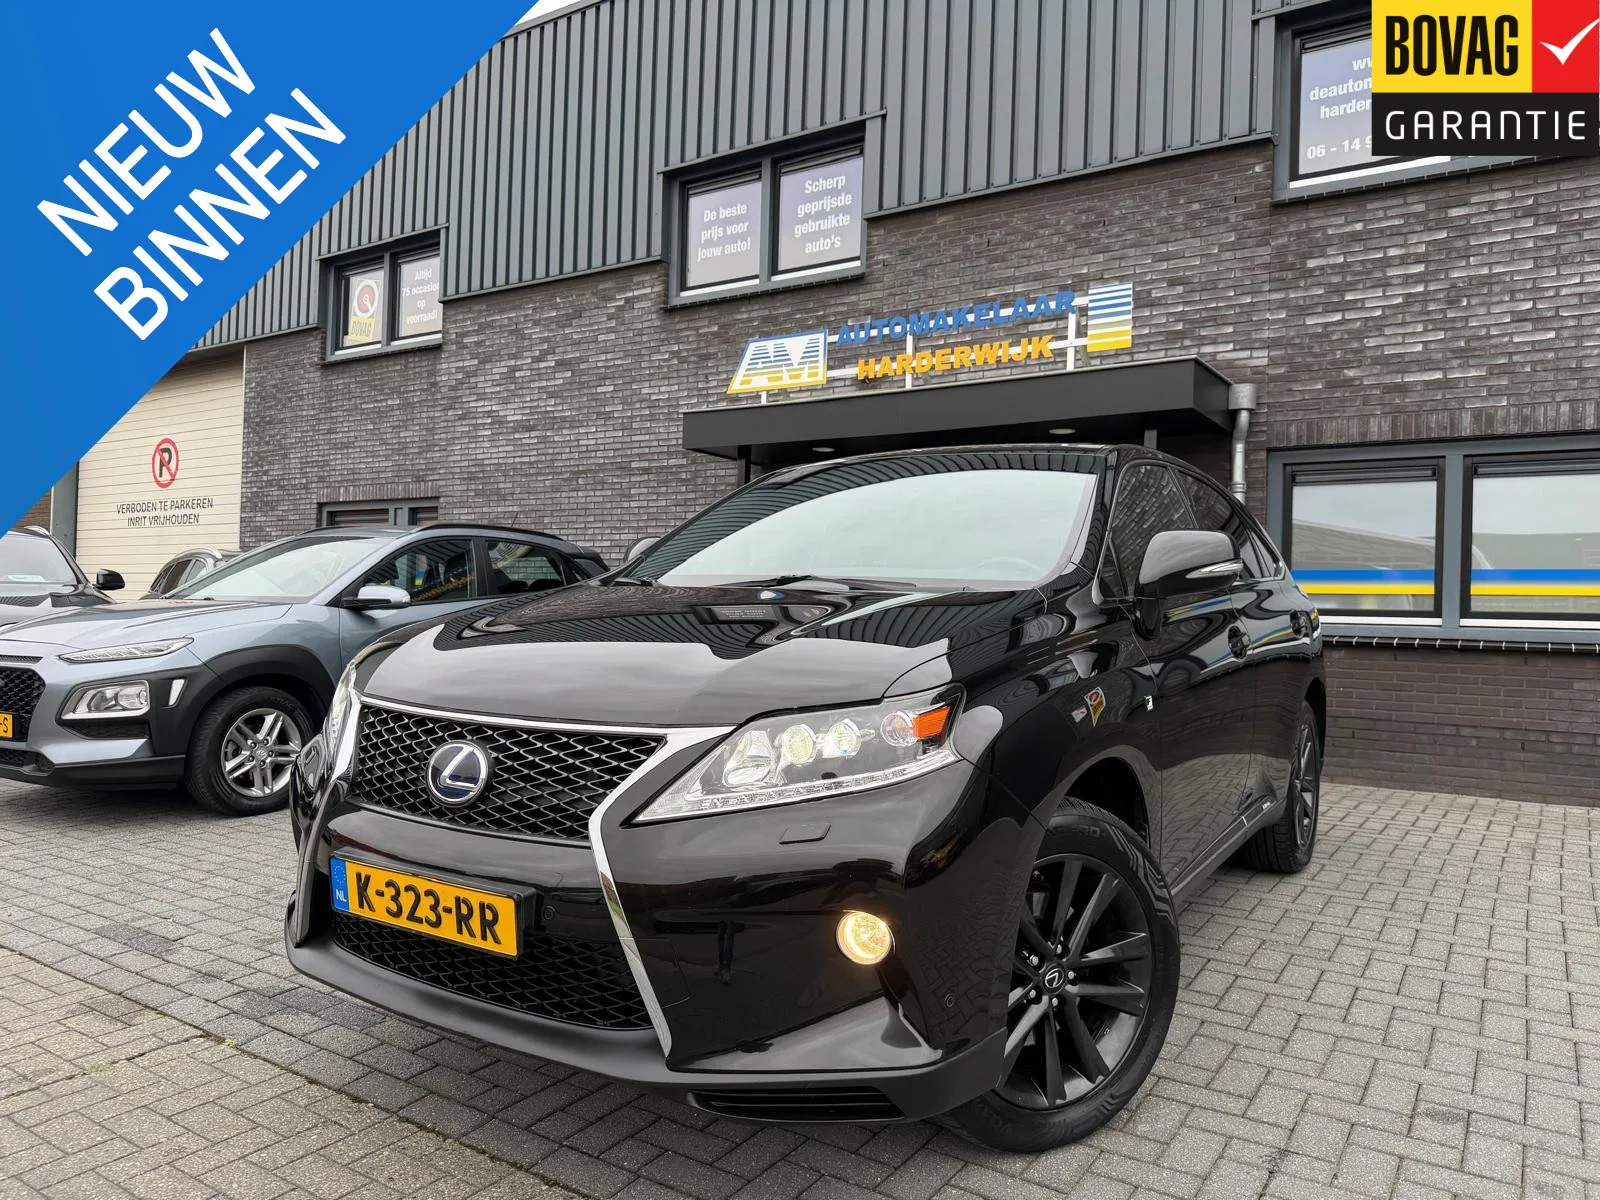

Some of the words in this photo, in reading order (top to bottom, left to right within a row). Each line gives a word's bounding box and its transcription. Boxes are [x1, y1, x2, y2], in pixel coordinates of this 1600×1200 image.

[1306, 144, 1326, 159] 06
[1341, 137, 1361, 153] 14
[804, 174, 846, 195] Scherp
[703, 209, 717, 223] De
[719, 202, 747, 220] beste
[797, 191, 852, 217] geprijsde
[701, 227, 723, 244] prijs
[726, 221, 749, 236] voor
[794, 212, 850, 238] gebruikte
[724, 237, 751, 257] auto!
[805, 234, 841, 254] auto's
[415, 267, 432, 281] Altijd
[835, 290, 1077, 349] AUTOMAKELAAR
[857, 334, 1056, 380] HARDERWIJK
[116, 501, 157, 514] VERBODEN
[159, 500, 169, 512] TE
[170, 497, 213, 511] PARKEREN
[127, 516, 146, 527] INRIT
[148, 513, 200, 526] VRIJHOUDEN
[335, 889, 347, 902] NL
[355, 871, 502, 945] K-323-RR
